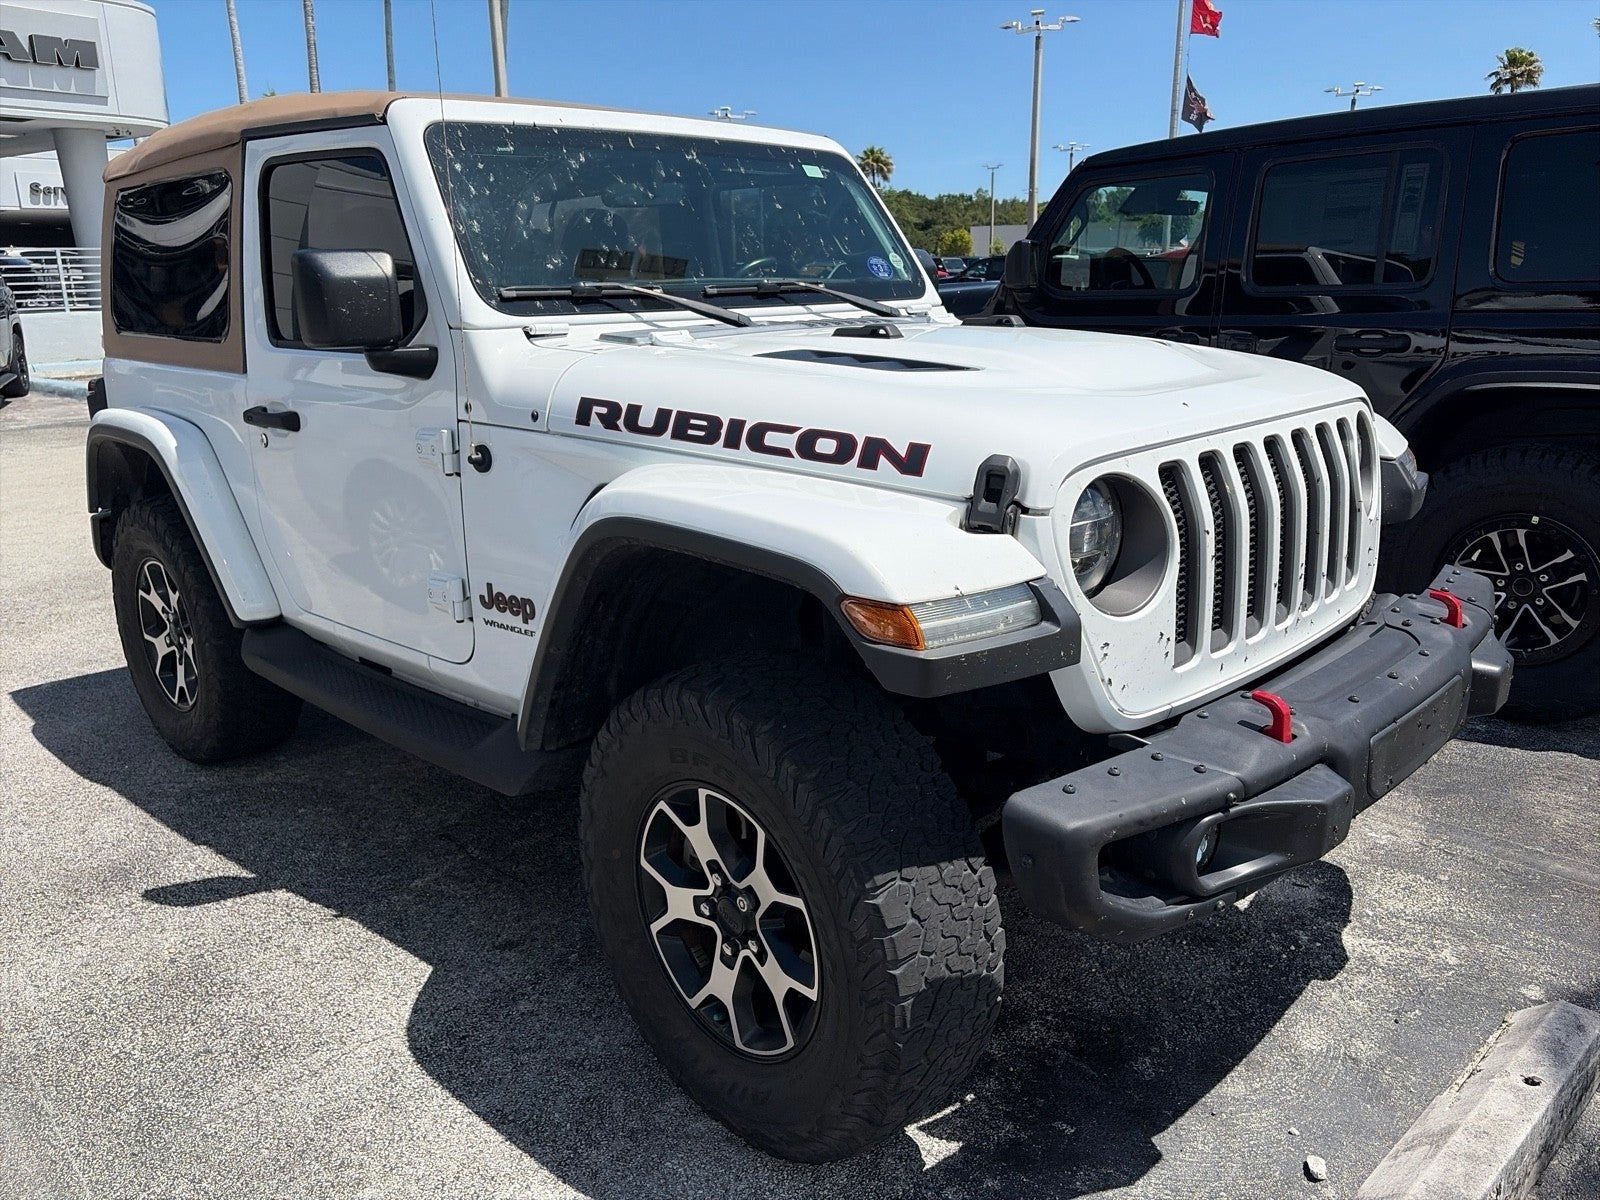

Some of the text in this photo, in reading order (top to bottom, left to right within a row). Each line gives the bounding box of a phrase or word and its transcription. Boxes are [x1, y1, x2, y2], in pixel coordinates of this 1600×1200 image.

[575, 396, 932, 477] RUBICON
[479, 582, 536, 625] Jeep
[483, 617, 536, 637] WRANGLER
